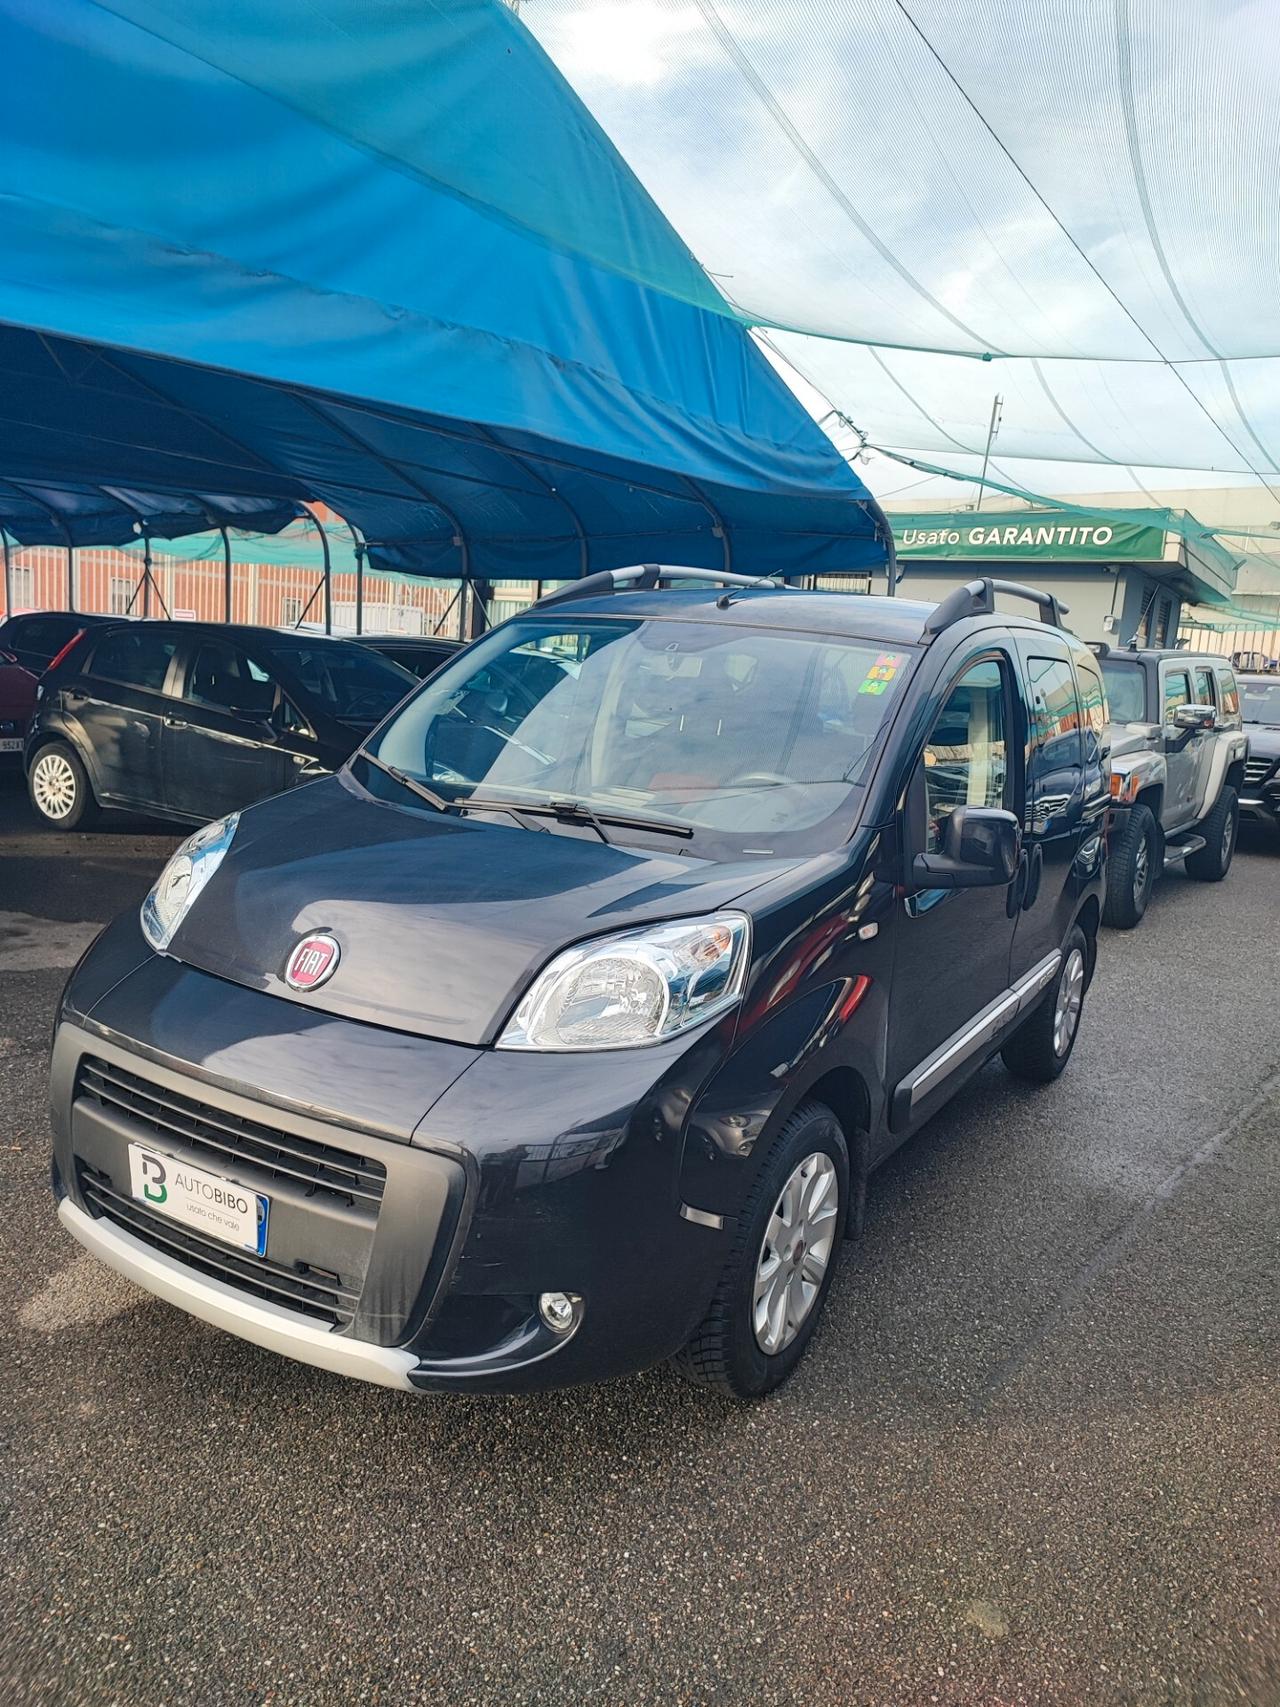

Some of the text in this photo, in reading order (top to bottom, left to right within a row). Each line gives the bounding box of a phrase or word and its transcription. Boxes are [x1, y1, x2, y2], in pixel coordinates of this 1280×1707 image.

[902, 526, 1114, 546] Usato GARANTITO
[294, 948, 328, 976] FIAT
[174, 1173, 248, 1214] AUTOBIBO
[186, 1203, 207, 1217] usato
[207, 1212, 223, 1224] che
